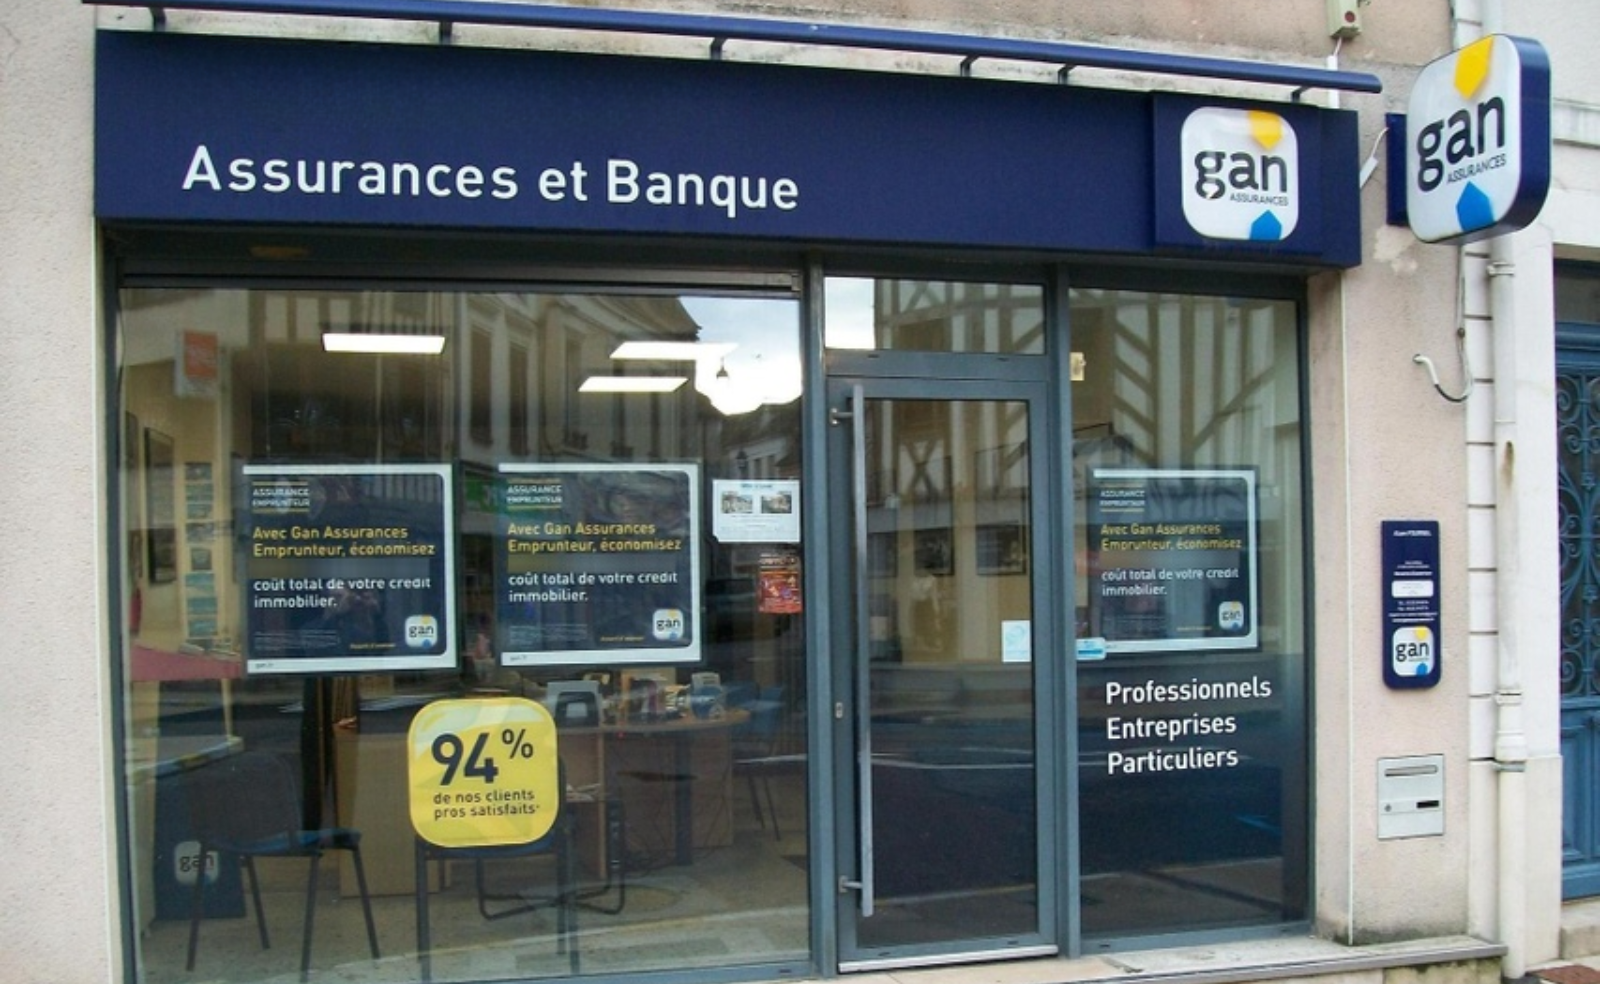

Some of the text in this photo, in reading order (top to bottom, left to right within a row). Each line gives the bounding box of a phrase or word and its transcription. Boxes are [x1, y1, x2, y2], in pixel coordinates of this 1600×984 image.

[1417, 95, 1506, 192] gan
[1194, 150, 1288, 200] gan
[1447, 152, 1507, 186] ASSURANCES
[182, 145, 800, 218] Assurances et Banque
[1229, 192, 1289, 207] ASSURANCES
[253, 488, 310, 496] ASSURANCE
[507, 485, 562, 494] ASSURANCE
[253, 526, 408, 539] Avec Gan Assurances
[508, 522, 655, 535] Avec Gan Assurances
[1101, 523, 1221, 535] Avec Gan Assurances
[508, 538, 681, 554] Emprunteur, économisez
[1176, 537, 1242, 549] économisez
[253, 542, 435, 559] Emprunteur, économisez
[542, 572, 575, 585] total
[578, 572, 595, 585] de
[598, 572, 634, 584] votre
[1129, 568, 1154, 580] total
[1159, 568, 1173, 580] de
[1175, 568, 1203, 579] votre
[289, 578, 322, 590] total
[327, 578, 344, 590] de
[349, 578, 385, 589] votre
[1102, 584, 1167, 596] immobilier.
[254, 595, 337, 608] immobilier.
[509, 590, 588, 602] immobilier.
[409, 623, 434, 637] gan
[656, 618, 681, 631] gan
[1395, 641, 1430, 663] gan
[1106, 676, 1272, 705] Professionnels
[1106, 713, 1237, 741] Entreprises
[1107, 747, 1239, 775] Particuliers
[433, 789, 535, 804] de nos clients
[434, 806, 466, 821] pros
